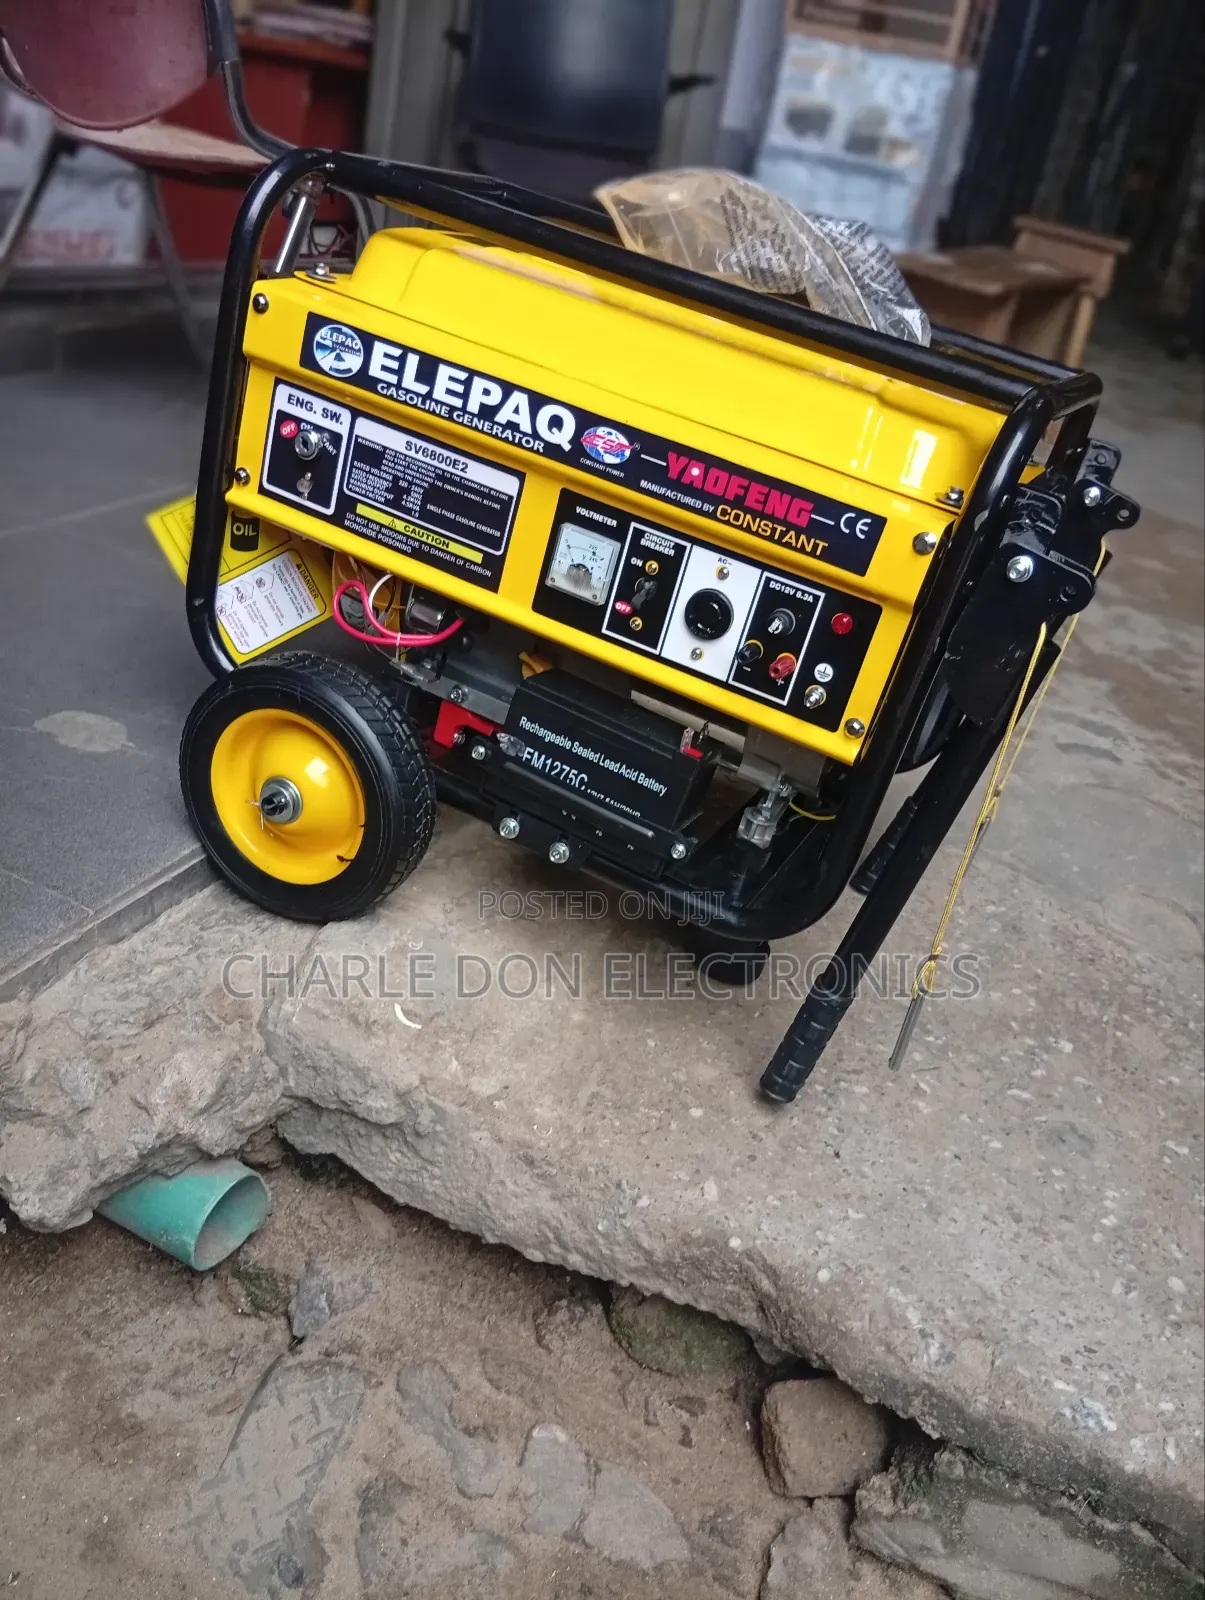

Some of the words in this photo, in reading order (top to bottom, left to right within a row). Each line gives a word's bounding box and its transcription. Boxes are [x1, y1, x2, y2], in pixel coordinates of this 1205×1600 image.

[287, 392, 317, 414] ENG.
[320, 406, 344, 425] SW.
[367, 340, 576, 451] ELEPAQ
[282, 422, 296, 436] OFF
[377, 382, 449, 418] GASOLINE
[453, 410, 544, 453] GENERATOR
[403, 439, 469, 474] SV6800E2
[370, 467, 393, 481] VOLTAGE
[667, 452, 814, 528] YAOFENG
[232, 522, 257, 537] OIL
[575, 505, 617, 528] VOLTMETER
[640, 479, 702, 508] MANUFACTURED
[702, 502, 715, 514] BY
[716, 504, 829, 556] CONSTANT
[840, 512, 872, 539] CE
[343, 519, 377, 538] MONOXIDE
[377, 533, 412, 553] POISONING
[345, 512, 354, 520] DO
[354, 516, 367, 526] NOT
[367, 521, 380, 531] USE
[380, 526, 407, 543] INDOORS
[406, 538, 419, 548] DUE
[420, 543, 429, 552] TO
[429, 547, 455, 563] DANGER
[456, 558, 464, 566] OF
[465, 562, 491, 577] CARBON
[402, 524, 450, 549] CAUTION
[639, 537, 675, 557] BREAKER
[643, 531, 675, 549] CIRCUIT
[630, 556, 643, 568] ON
[299, 570, 319, 599] DANGER
[768, 580, 795, 596] DC12V
[614, 601, 631, 614] OFF
[519, 716, 572, 750] Rechargeable
[572, 741, 599, 763] Sealed
[599, 754, 619, 773] Lead
[619, 765, 638, 782] Acid
[637, 773, 668, 797] Battery
